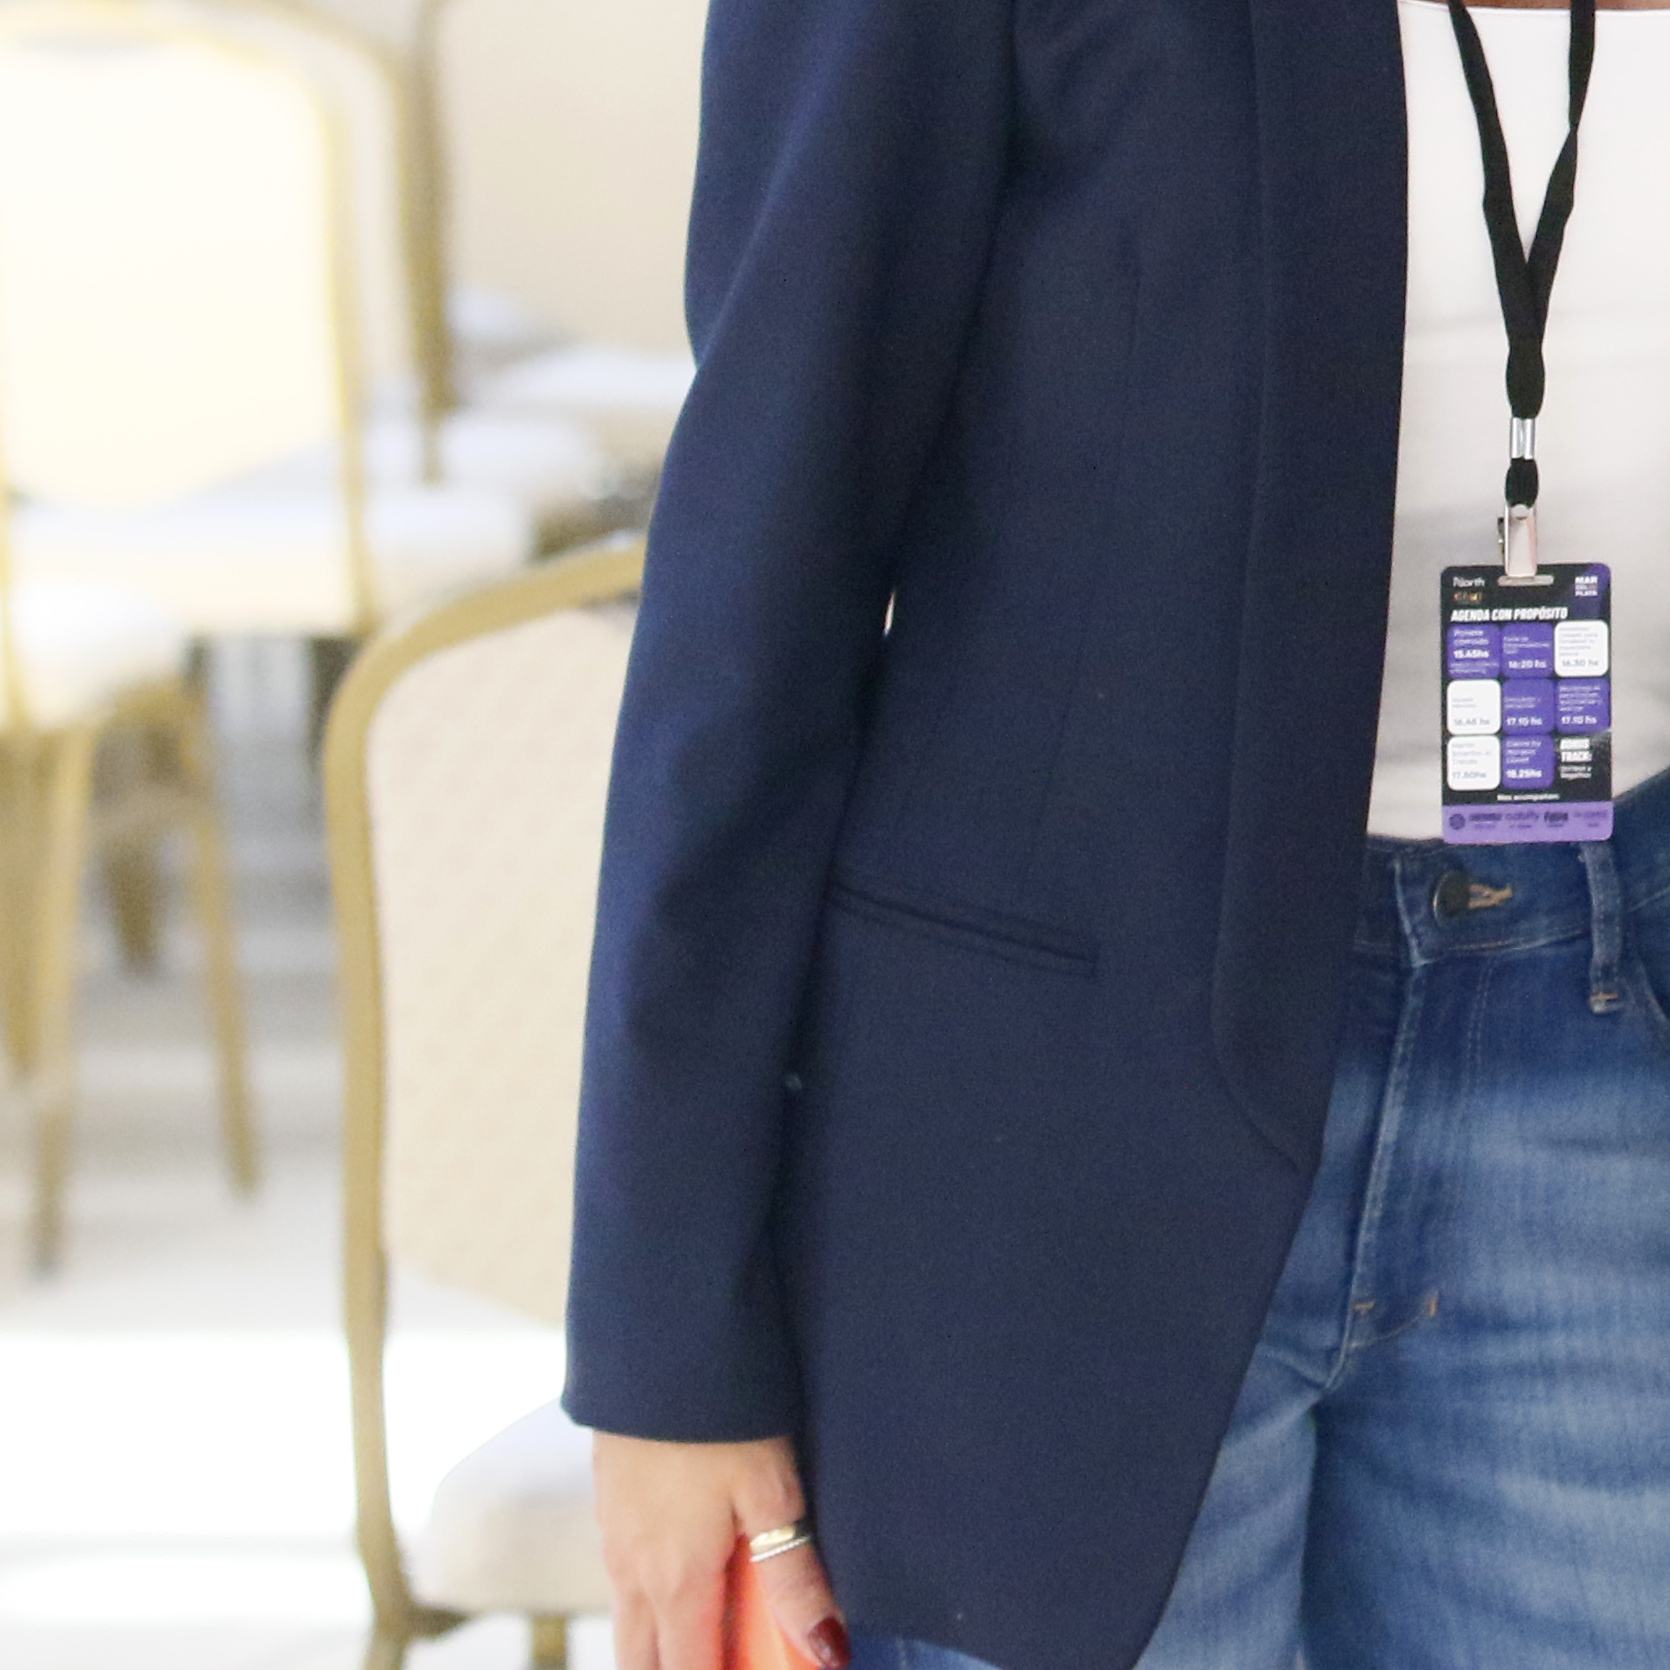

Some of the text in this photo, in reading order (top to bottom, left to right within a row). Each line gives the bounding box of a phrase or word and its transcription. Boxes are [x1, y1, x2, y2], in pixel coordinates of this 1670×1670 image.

[1451, 605, 1569, 622] AGENDA CON PROPÓSITO
